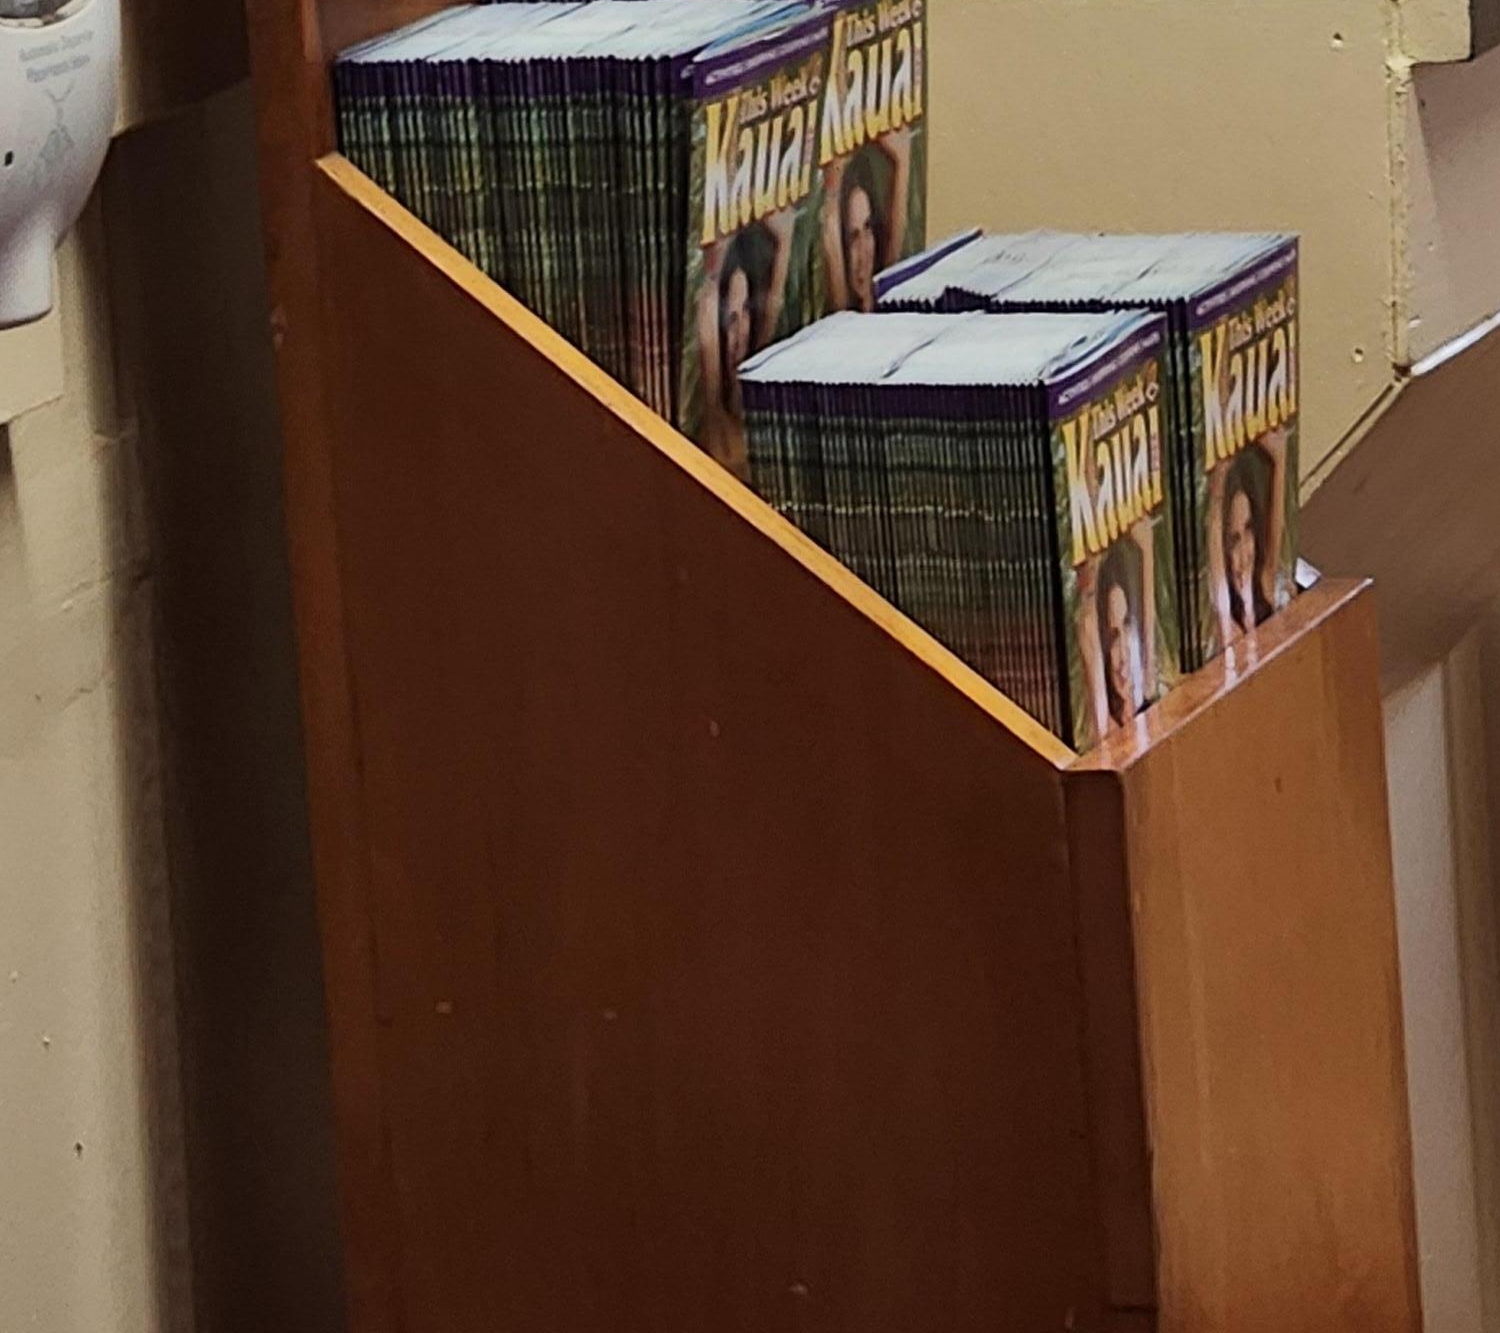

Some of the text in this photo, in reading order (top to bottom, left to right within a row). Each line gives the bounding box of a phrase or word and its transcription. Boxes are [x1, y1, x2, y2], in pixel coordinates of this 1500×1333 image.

[848, 13, 875, 48] This
[740, 70, 808, 126] This Week
[821, 13, 923, 167] Kauai
[701, 93, 817, 244] Kauai
[1230, 291, 1286, 351] This Week
[1092, 381, 1146, 439] This Week
[1200, 318, 1296, 471] Kauai
[1062, 405, 1163, 567] Kauai
